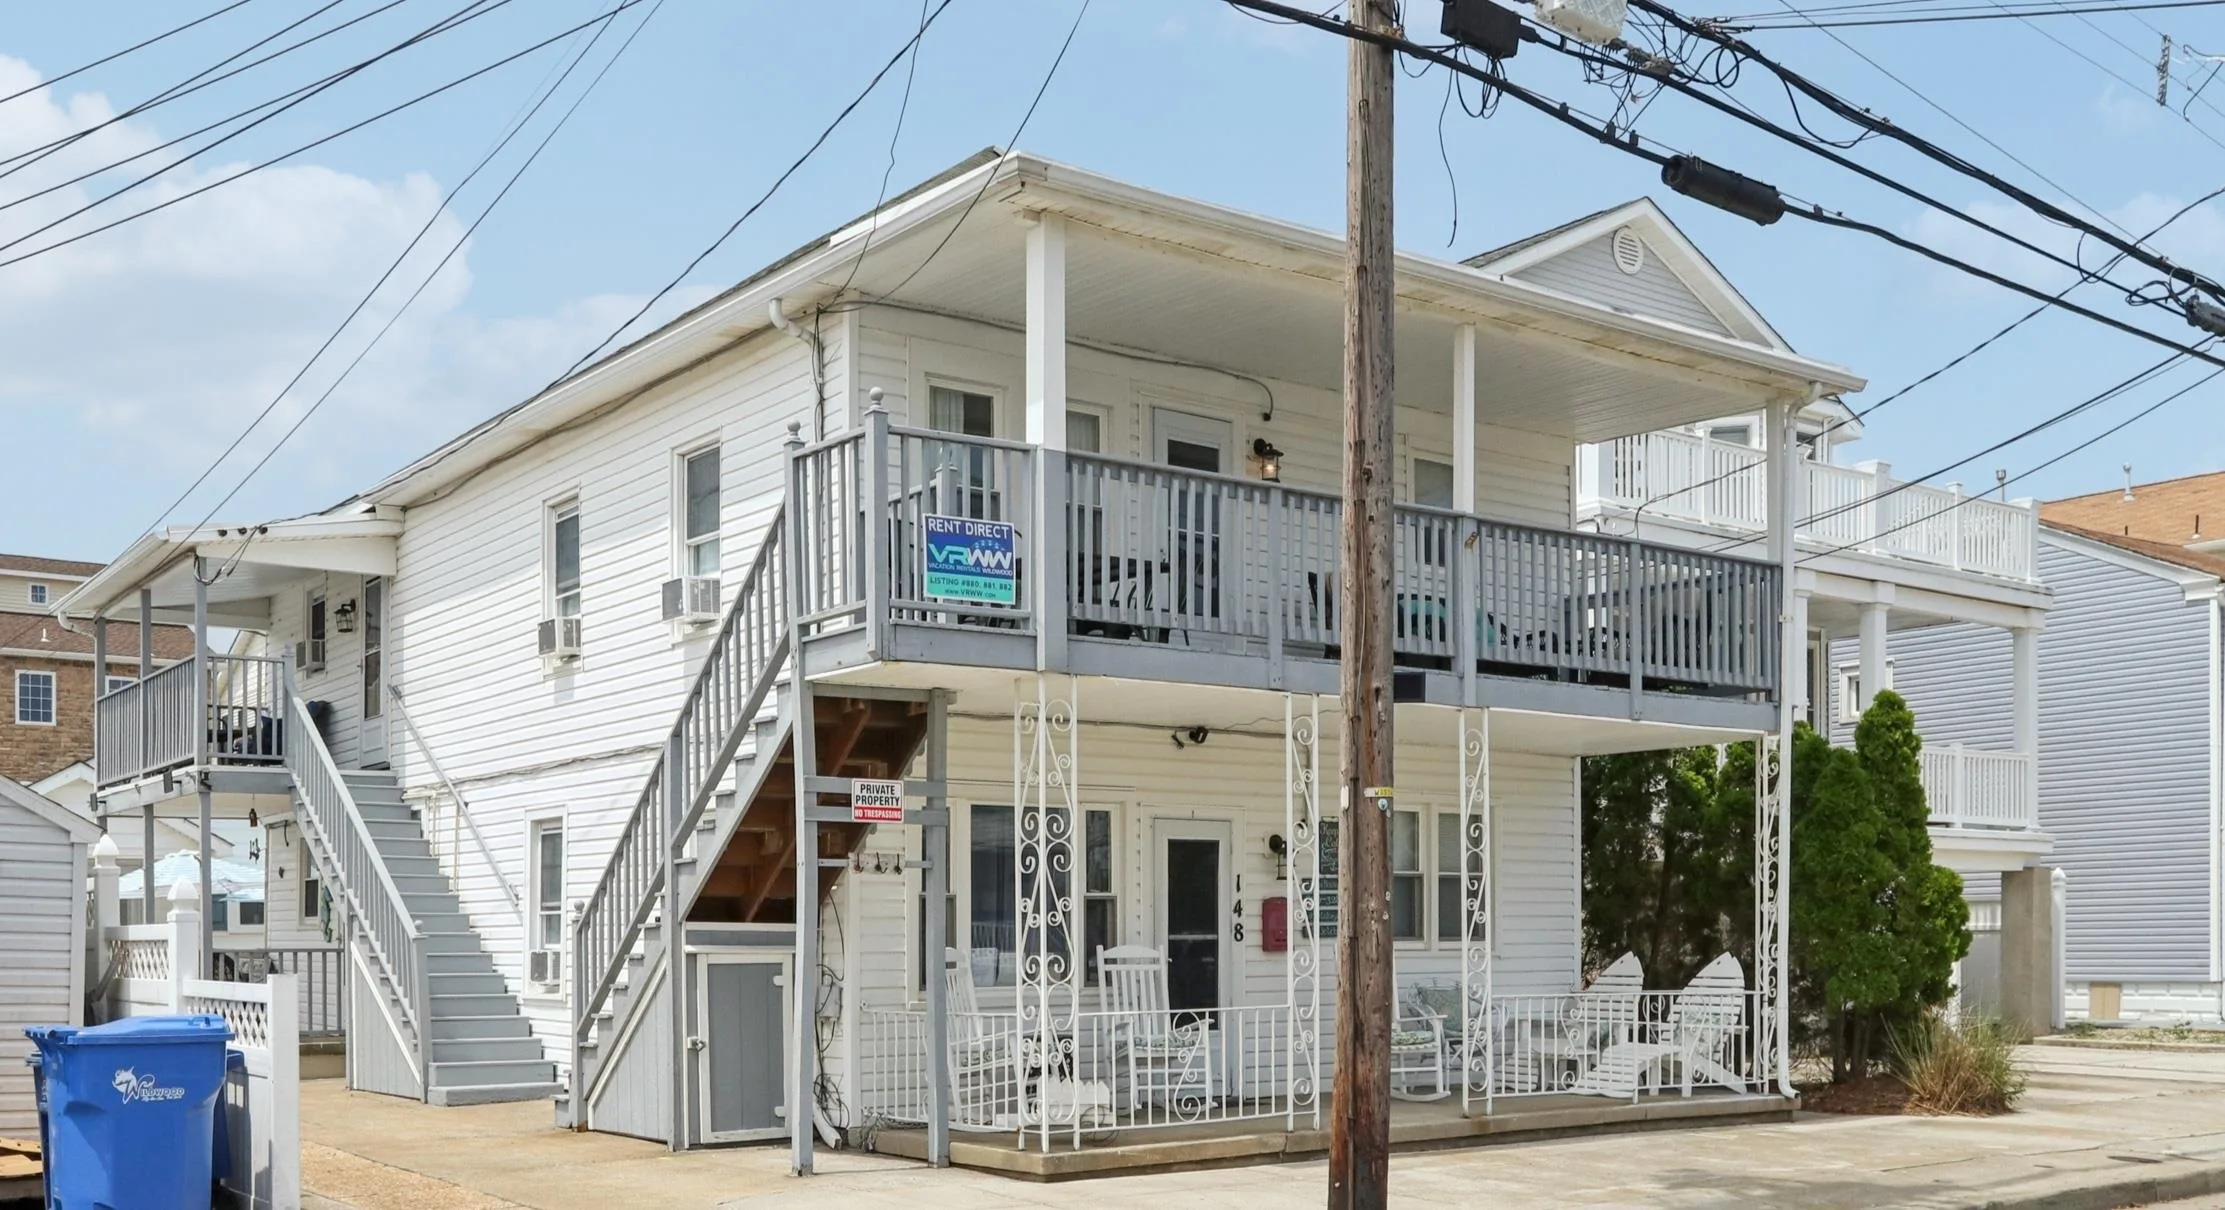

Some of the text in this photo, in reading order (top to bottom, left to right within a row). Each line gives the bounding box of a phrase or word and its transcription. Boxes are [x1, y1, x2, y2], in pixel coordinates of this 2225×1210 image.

[928, 518, 1009, 539] RENT DIRECT
[928, 543, 1012, 569] VRWW
[930, 577, 959, 585] LISTING
[861, 784, 895, 795] PRIVATE
[856, 795, 900, 806] PROPERTY
[855, 809, 901, 819] NO TRESPASSING
[1233, 874, 1244, 942] 148
